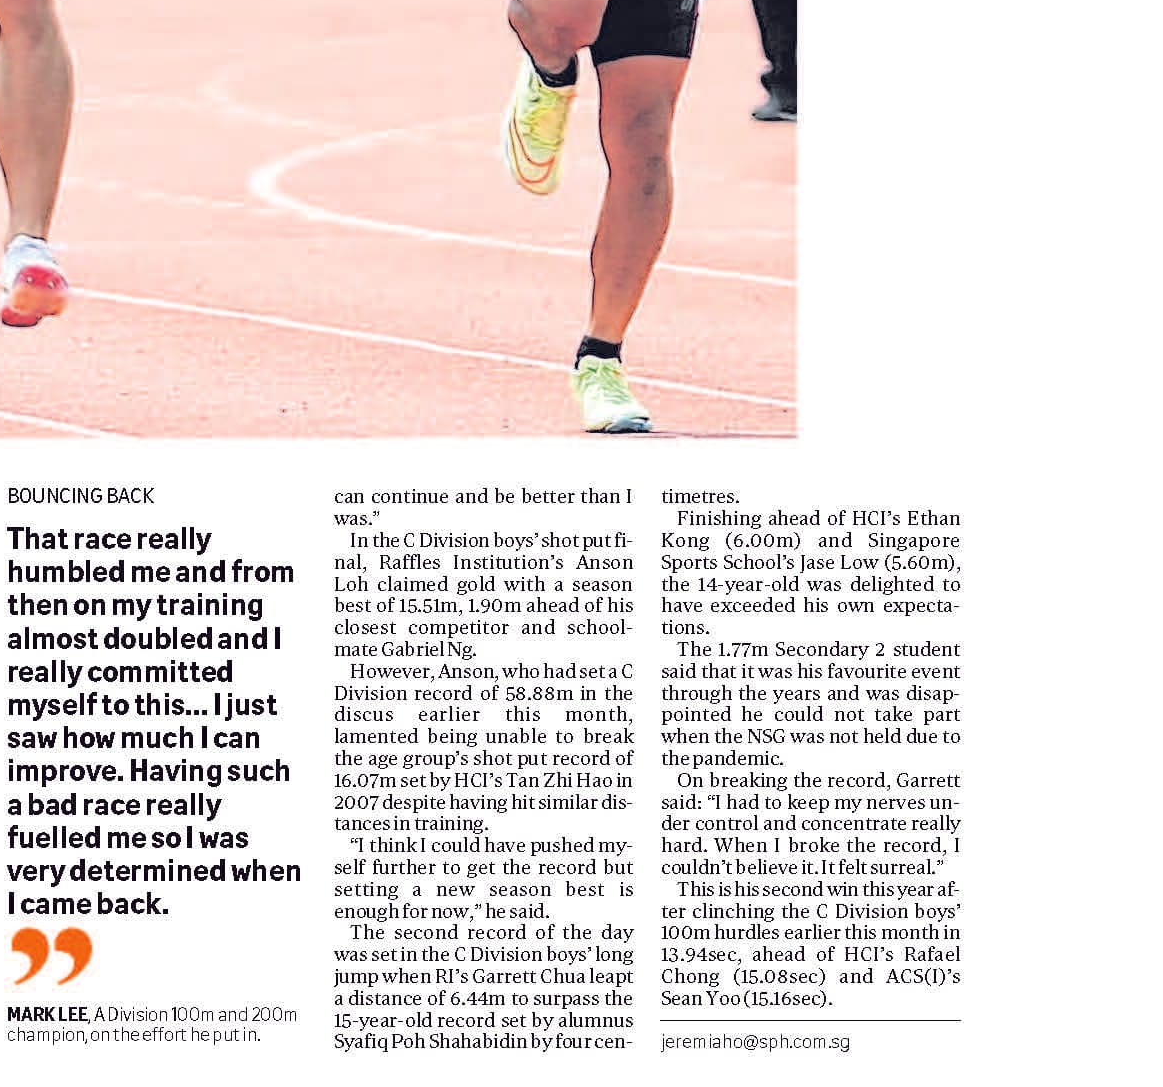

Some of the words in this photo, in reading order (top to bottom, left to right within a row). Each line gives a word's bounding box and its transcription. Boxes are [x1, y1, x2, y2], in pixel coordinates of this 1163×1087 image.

[8, 487, 103, 504] BOUNCING
[107, 487, 155, 504] BACK
[661, 488, 740, 504] timetres.
[6, 526, 69, 550] That
[74, 532, 132, 550] race
[137, 526, 213, 556] really
[661, 532, 710, 552] Kong
[725, 531, 801, 551] (6.00m)
[818, 531, 853, 548] and
[868, 532, 960, 552] Singapore
[334, 575, 369, 592] Loh
[377, 575, 449, 592] claimed
[456, 575, 496, 596] gold
[503, 575, 546, 592] with
[554, 580, 564, 592] a
[572, 580, 633, 592] season
[661, 596, 703, 613] have
[710, 596, 796, 613] exceeded
[803, 596, 829, 613] his
[837, 601, 875, 613] own
[883, 599, 960, 617] expecta-
[7, 626, 99, 650] almost
[103, 626, 213, 650] doubled
[217, 626, 268, 650] and
[274, 626, 281, 650] I
[334, 618, 397, 635] closest
[408, 619, 510, 639] competitor
[521, 618, 556, 635] and
[567, 618, 633, 635] school-
[334, 727, 419, 744] lamented
[427, 727, 478, 748] being
[485, 727, 547, 744] unable
[555, 730, 574, 744] to
[583, 727, 635, 744] break
[8, 758, 124, 788] improve.
[130, 758, 222, 788] Having
[227, 758, 290, 782] such
[7, 1005, 56, 1022] MARK
[58, 1006, 91, 1025] LEE,
[93, 1006, 106, 1022] A
[108, 1005, 168, 1022] Division
[171, 1006, 214, 1023] 100m
[218, 1006, 248, 1022] and
[251, 1006, 297, 1023] 200m
[660, 1032, 850, 1053] jeremiaho@sph.com.sg
